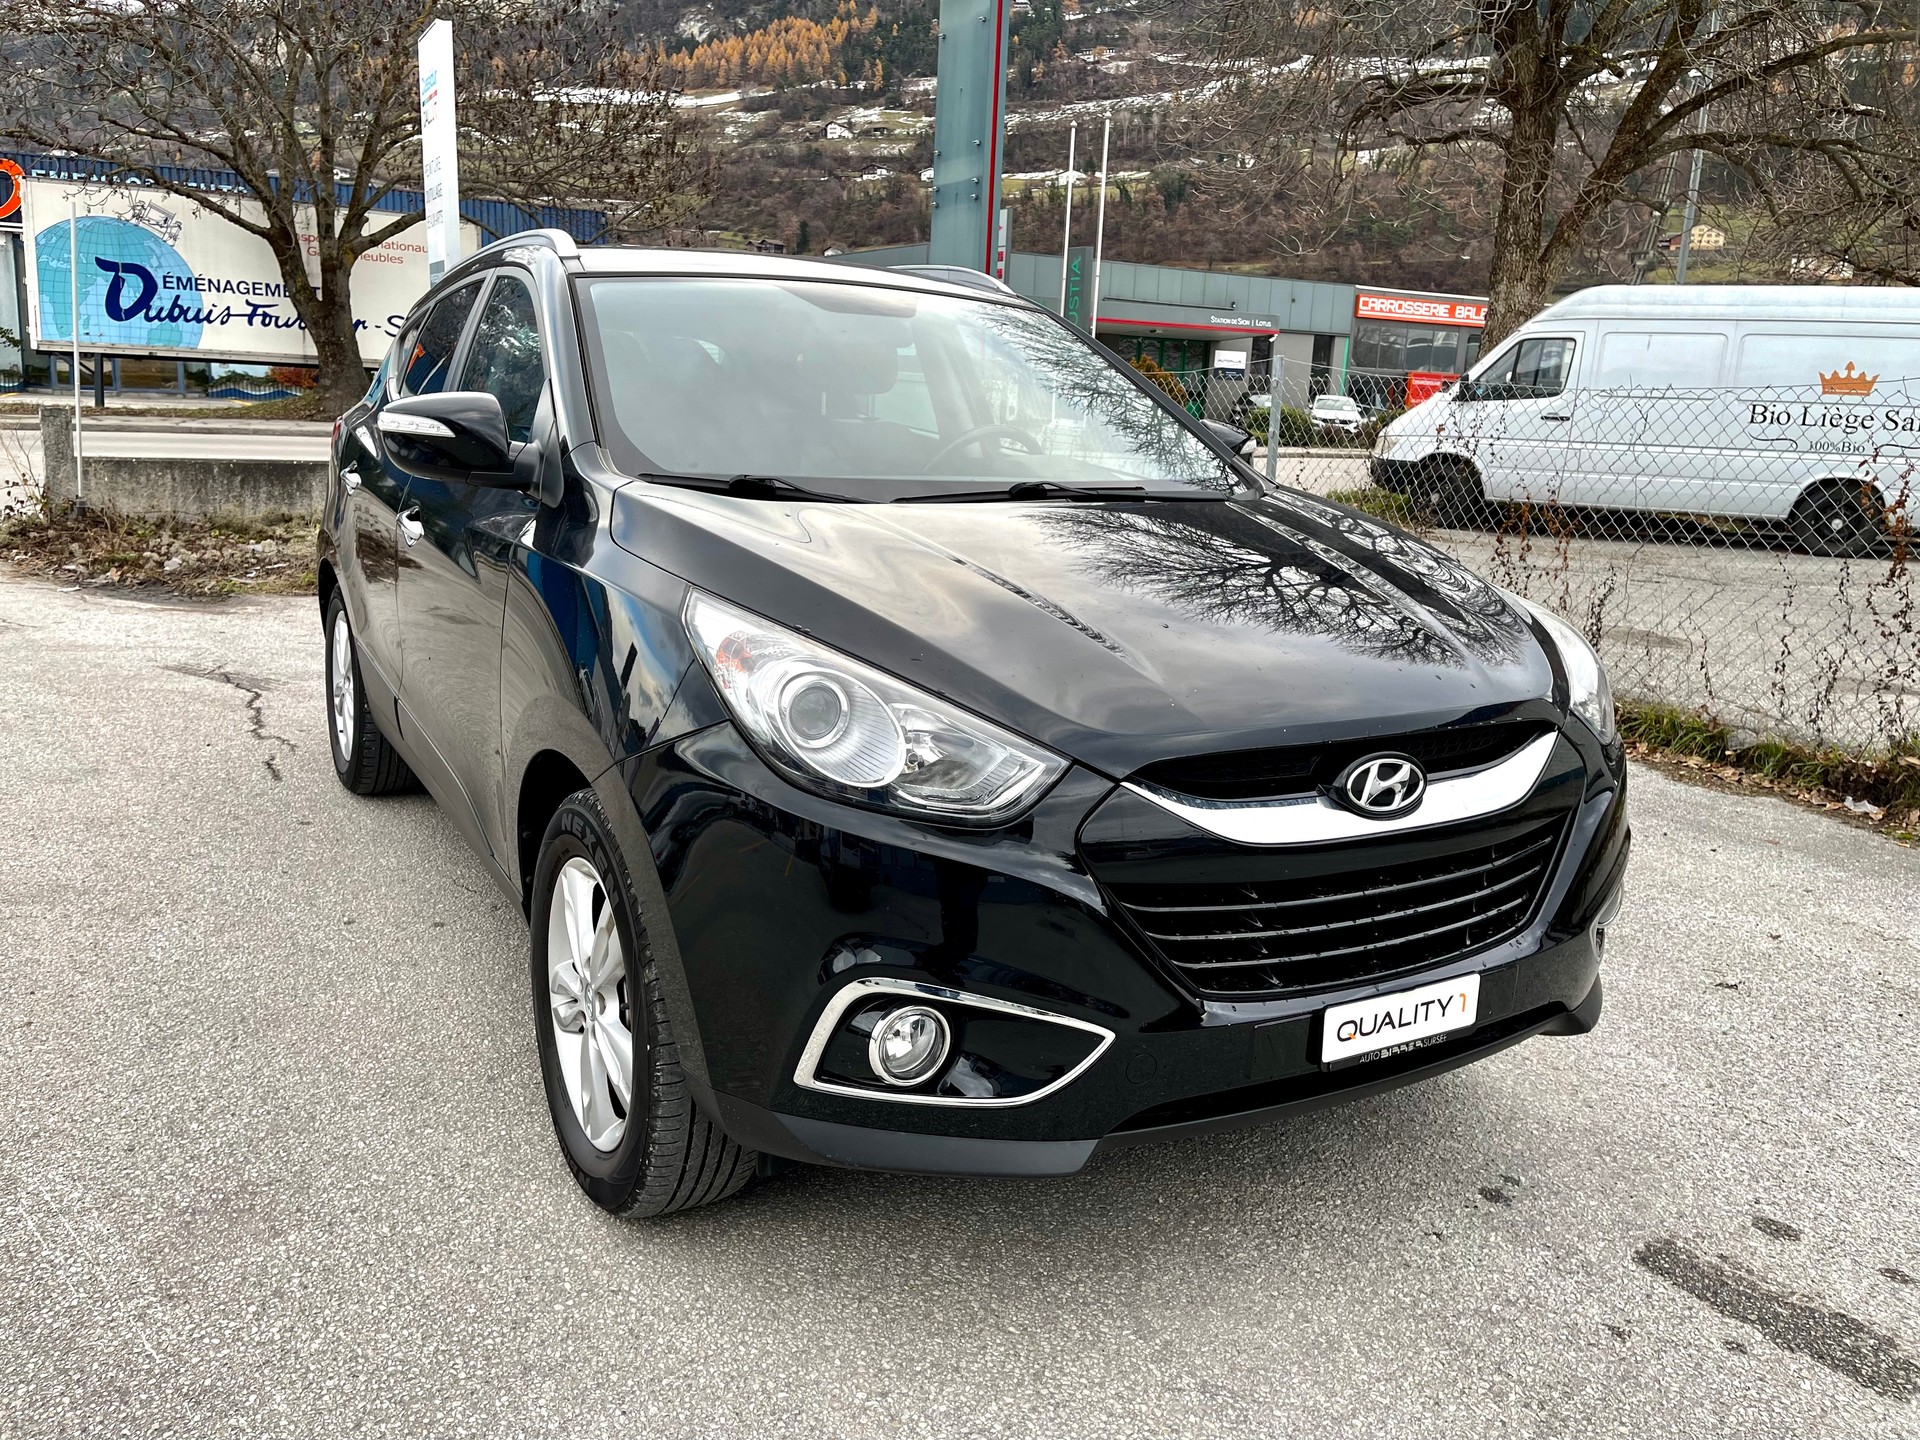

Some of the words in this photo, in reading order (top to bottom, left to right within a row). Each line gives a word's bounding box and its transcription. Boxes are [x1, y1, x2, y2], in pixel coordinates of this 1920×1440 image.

[1068, 255, 1082, 326] USTIA
[1359, 296, 1451, 317] CARROSSERIE
[1748, 402, 1791, 426] Bio
[1800, 404, 1875, 436] Liège
[561, 813, 620, 909] NEXEN
[1337, 994, 1455, 1043] QUALITY
[1359, 1050, 1381, 1064] AUTO
